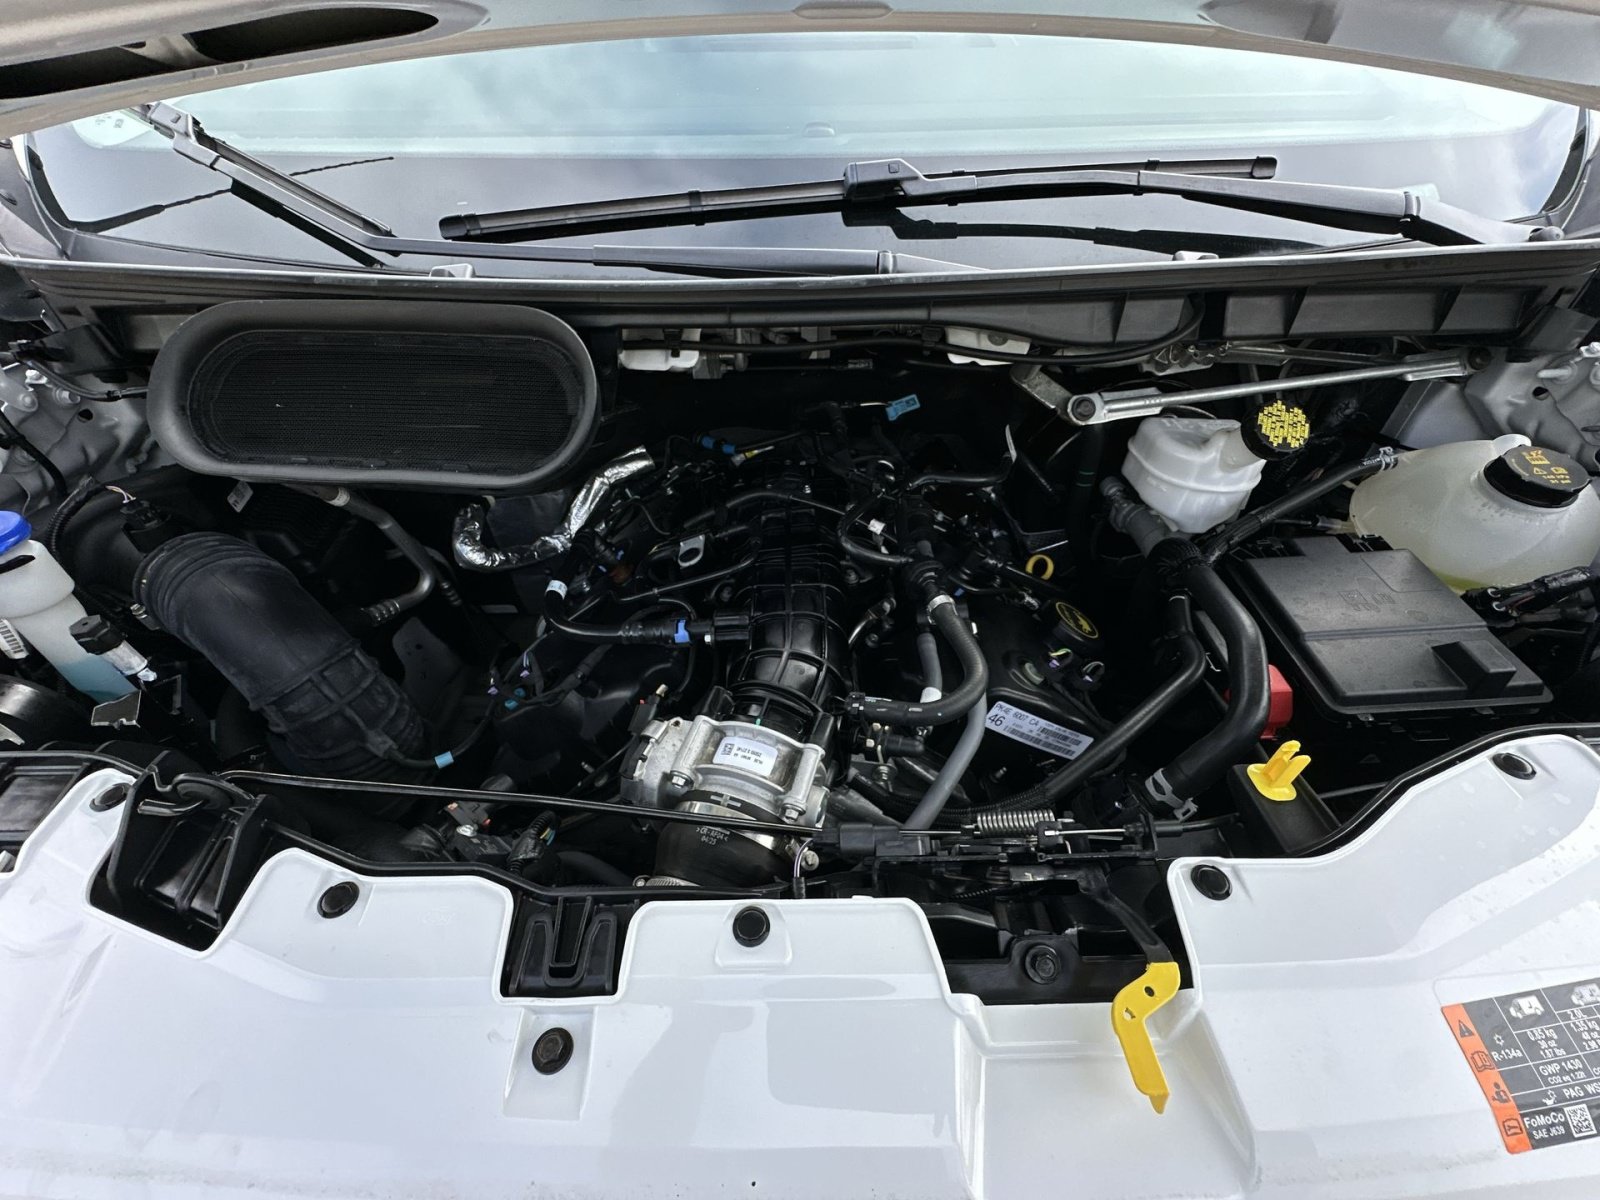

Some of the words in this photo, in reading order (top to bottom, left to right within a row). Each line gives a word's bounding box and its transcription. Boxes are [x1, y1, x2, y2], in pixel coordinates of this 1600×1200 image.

[988, 714, 1006, 727] 46
[1029, 718, 1040, 726] CA
[1567, 1009, 1588, 1020] 2.0L
[1570, 1020, 1588, 1032] 1.35
[1527, 1028, 1546, 1041] 0.85
[1542, 1027, 1558, 1040] kg
[1491, 1048, 1523, 1061] R-134a
[1539, 1063, 1561, 1075] GWP
[1562, 1058, 1583, 1071] 1430
[1548, 1075, 1563, 1084] CO2
[1562, 1086, 1585, 1099] PAG
[1523, 1112, 1565, 1128] FoMoCo
[1532, 1129, 1549, 1140] SAE
[1550, 1125, 1566, 1137] J639
